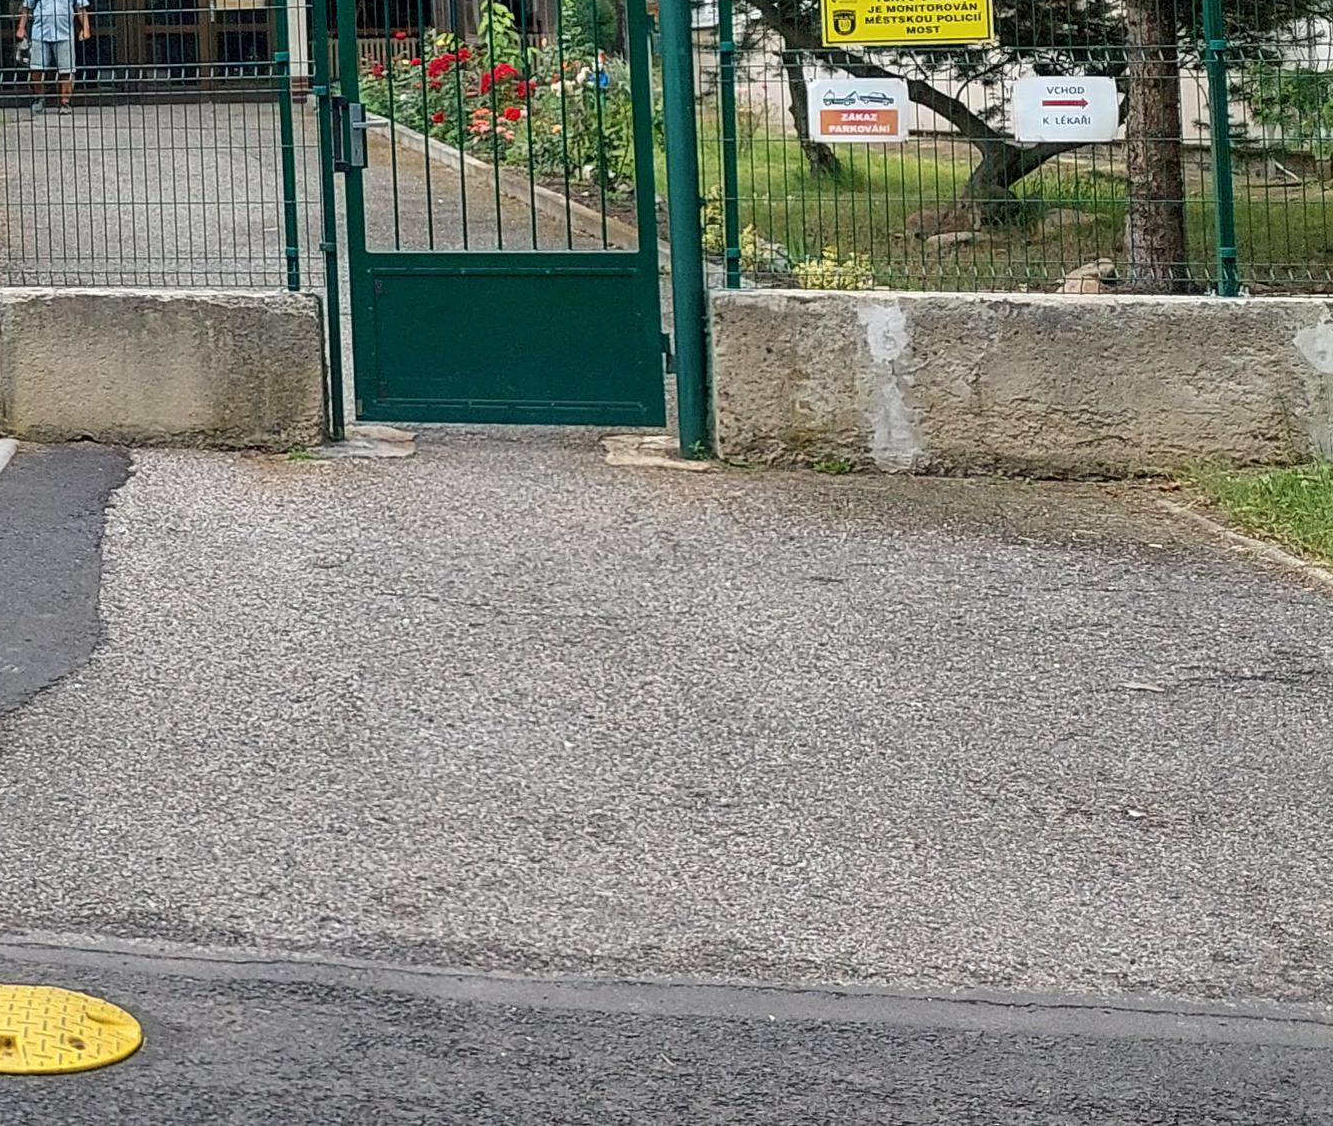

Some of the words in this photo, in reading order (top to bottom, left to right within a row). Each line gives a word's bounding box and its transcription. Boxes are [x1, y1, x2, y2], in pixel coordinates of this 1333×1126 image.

[867, 6, 882, 14] JE
[886, 1, 978, 12] MONITOROVÁN
[906, 25, 941, 34] MOST
[1046, 86, 1085, 95] VCHOD
[1042, 116, 1050, 125] K
